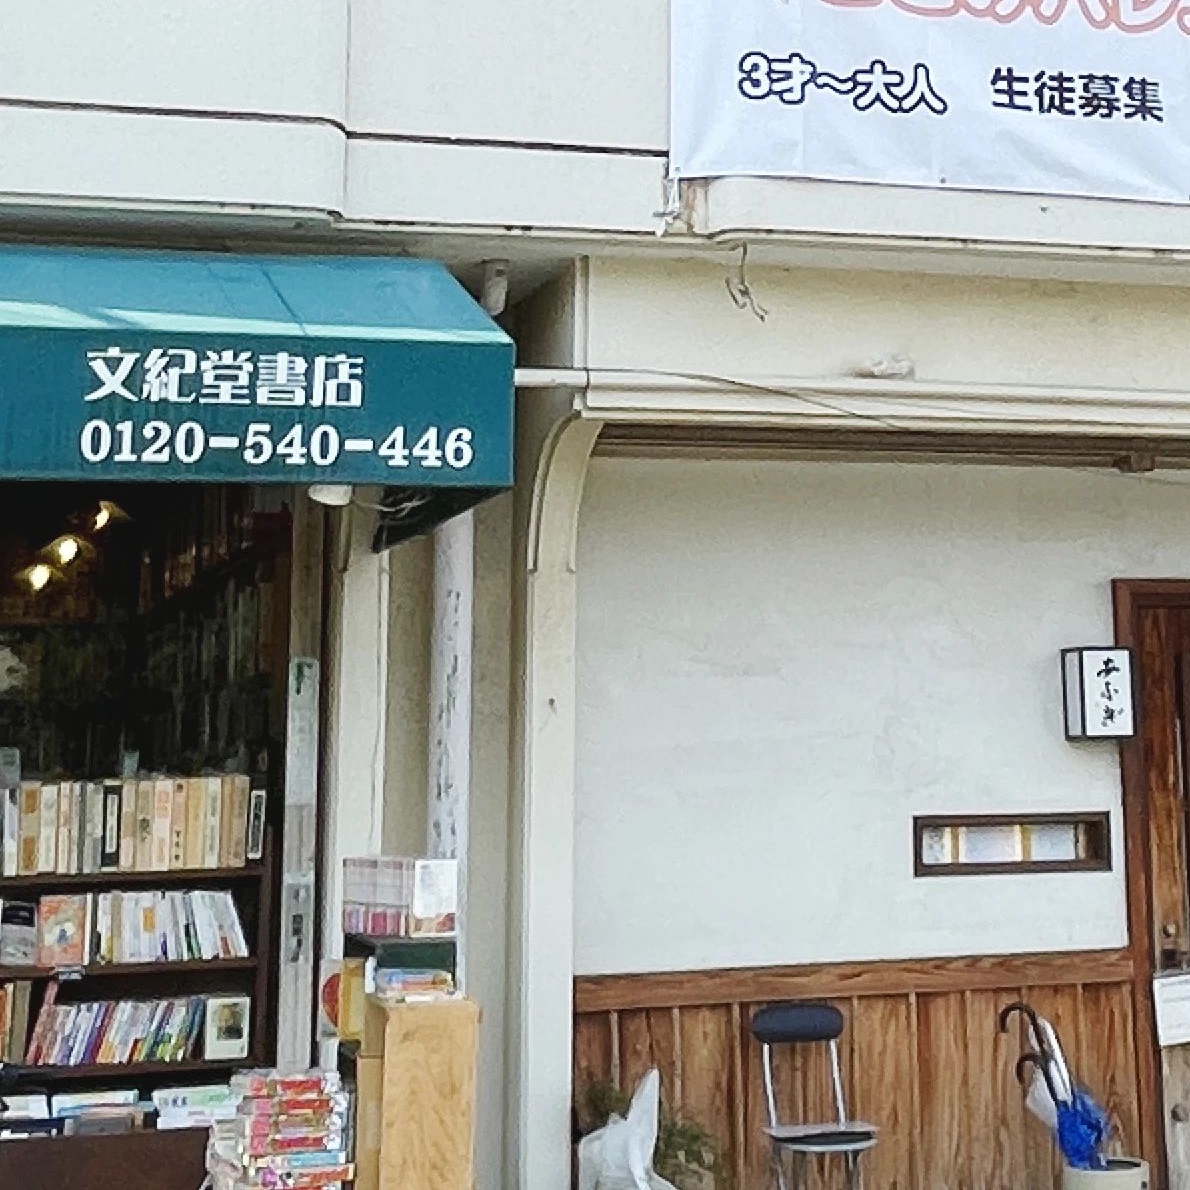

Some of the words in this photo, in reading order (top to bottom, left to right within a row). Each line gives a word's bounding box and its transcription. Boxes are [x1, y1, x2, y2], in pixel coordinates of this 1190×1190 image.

[990, 67, 1164, 122] 生徒募集
[84, 345, 365, 408] 文紀堂書店
[80, 418, 475, 470] 0120-540-446
